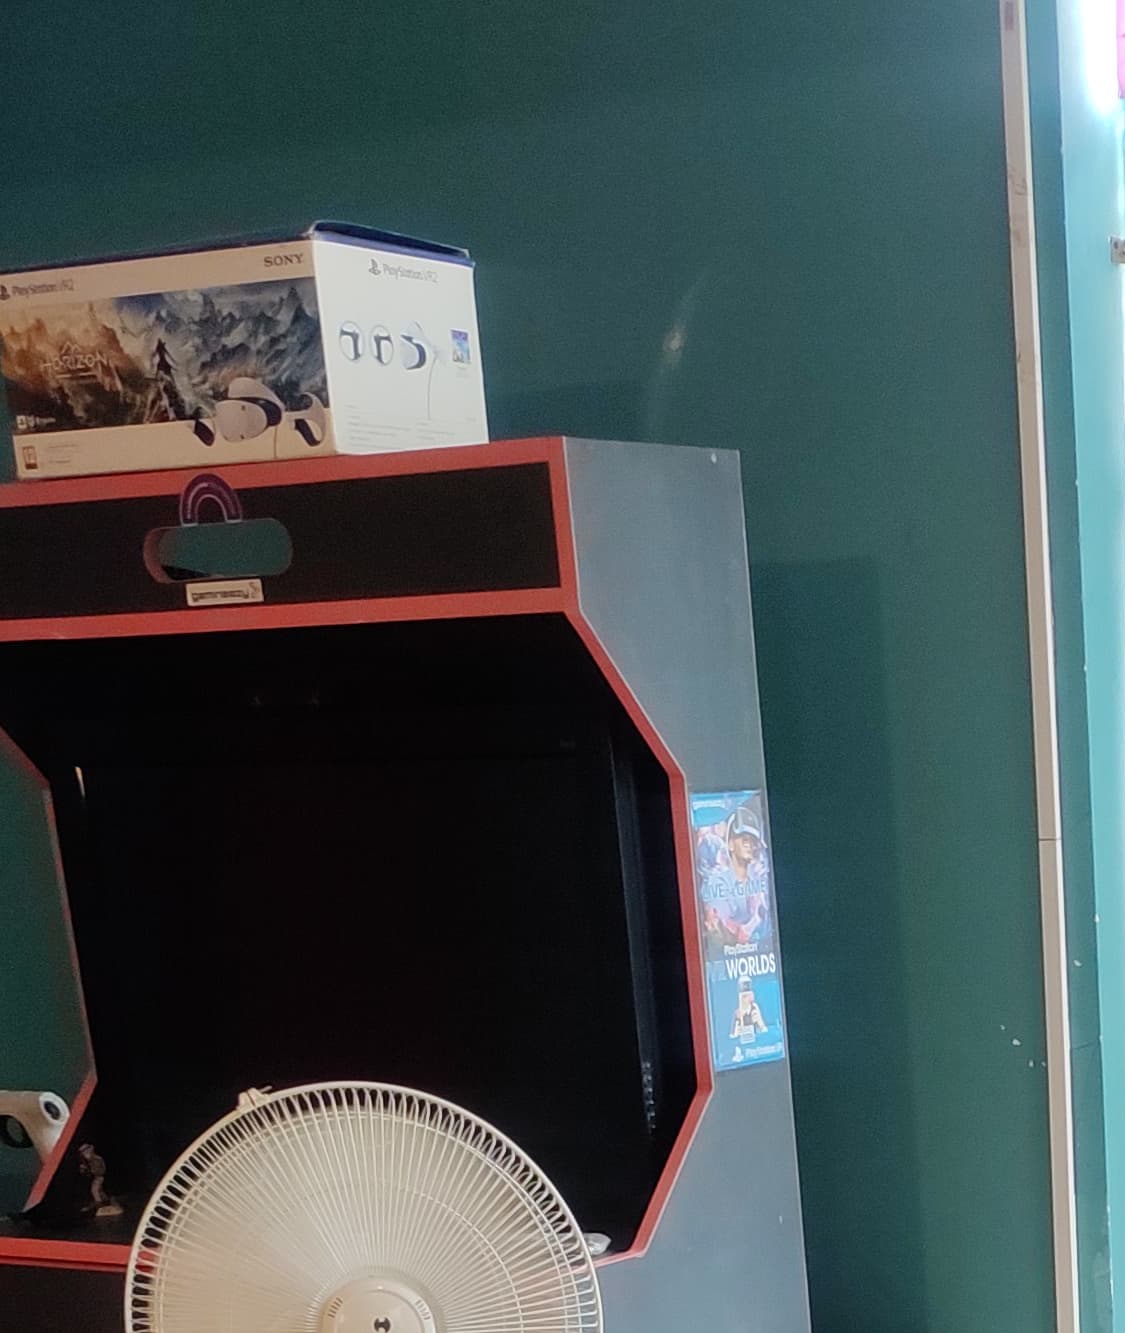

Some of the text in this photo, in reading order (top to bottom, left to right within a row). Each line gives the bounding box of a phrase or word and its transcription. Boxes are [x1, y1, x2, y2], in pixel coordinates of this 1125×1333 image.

[264, 253, 305, 268] SONY
[41, 351, 108, 372] HORIZON
[725, 952, 776, 979] WORLDS
